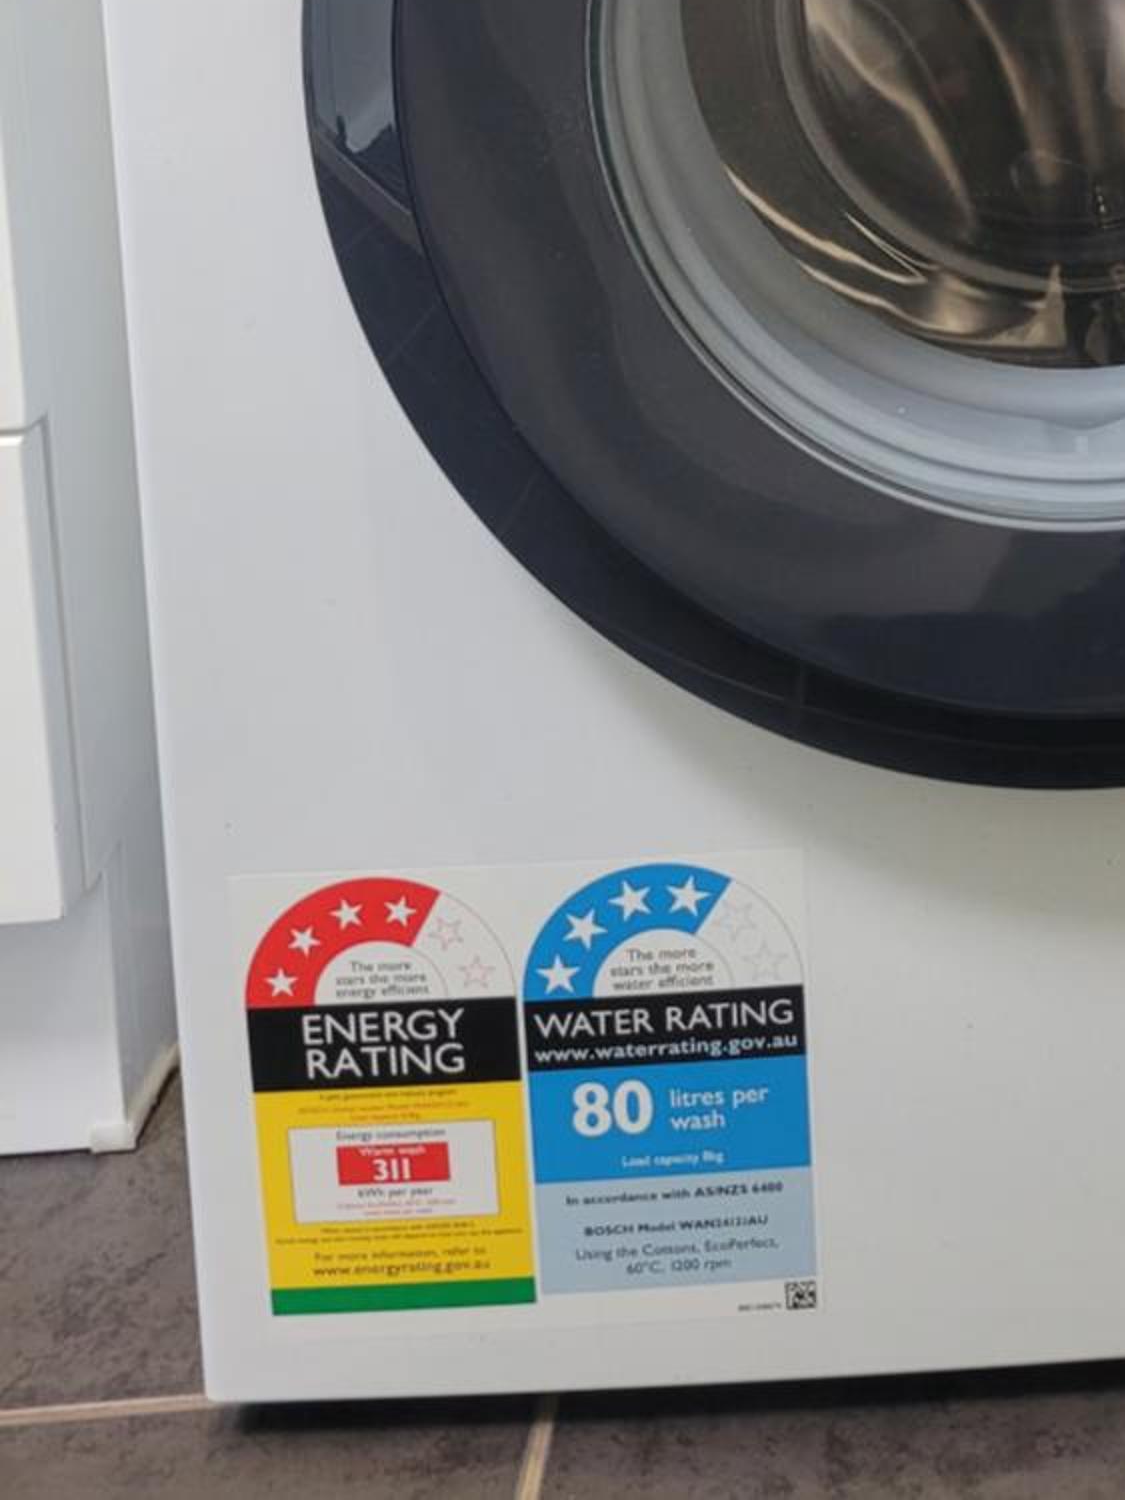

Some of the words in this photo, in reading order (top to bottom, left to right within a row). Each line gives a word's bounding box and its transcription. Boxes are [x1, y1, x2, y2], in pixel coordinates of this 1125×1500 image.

[626, 949, 653, 961] The
[658, 948, 696, 960] more
[349, 961, 374, 972] The
[377, 963, 411, 972] more
[610, 966, 644, 977] stars
[648, 962, 671, 975] the
[675, 962, 715, 973] more
[336, 976, 365, 986] stars
[368, 973, 388, 985] the
[393, 973, 427, 982] more
[612, 979, 652, 990] water
[658, 975, 715, 989] efficient
[336, 988, 376, 1000] energy
[381, 984, 429, 997] efficient
[301, 1007, 465, 1046] ENERGY
[534, 1008, 654, 1039] WATER
[665, 999, 795, 1032] RATING
[534, 1033, 798, 1064] www.waterrating.gov.au
[305, 1041, 466, 1080] RATING
[669, 1087, 724, 1109] litres
[733, 1087, 769, 1110] per
[571, 1078, 655, 1138] 80
[670, 1111, 726, 1131] wash
[336, 1129, 372, 1142] Energy
[376, 1126, 447, 1140] consumption
[622, 1154, 649, 1168] Load
[653, 1154, 700, 1168] capacity
[702, 1150, 725, 1165] 8kg
[372, 1156, 412, 1181] 311
[388, 1188, 407, 1199] per
[411, 1187, 434, 1199] year
[565, 1195, 578, 1206] In
[583, 1190, 658, 1206] accordance
[661, 1187, 690, 1200] with
[751, 1181, 784, 1195] 6400
[583, 1223, 634, 1238] BOSCH
[637, 1220, 675, 1234] Model
[314, 1250, 334, 1262] For
[338, 1251, 368, 1262] more
[442, 1246, 471, 1258] refer
[474, 1246, 487, 1256] to
[575, 1248, 613, 1262] Using
[616, 1244, 638, 1259] the
[671, 1258, 700, 1273] 1200
[703, 1258, 732, 1272] rpm
